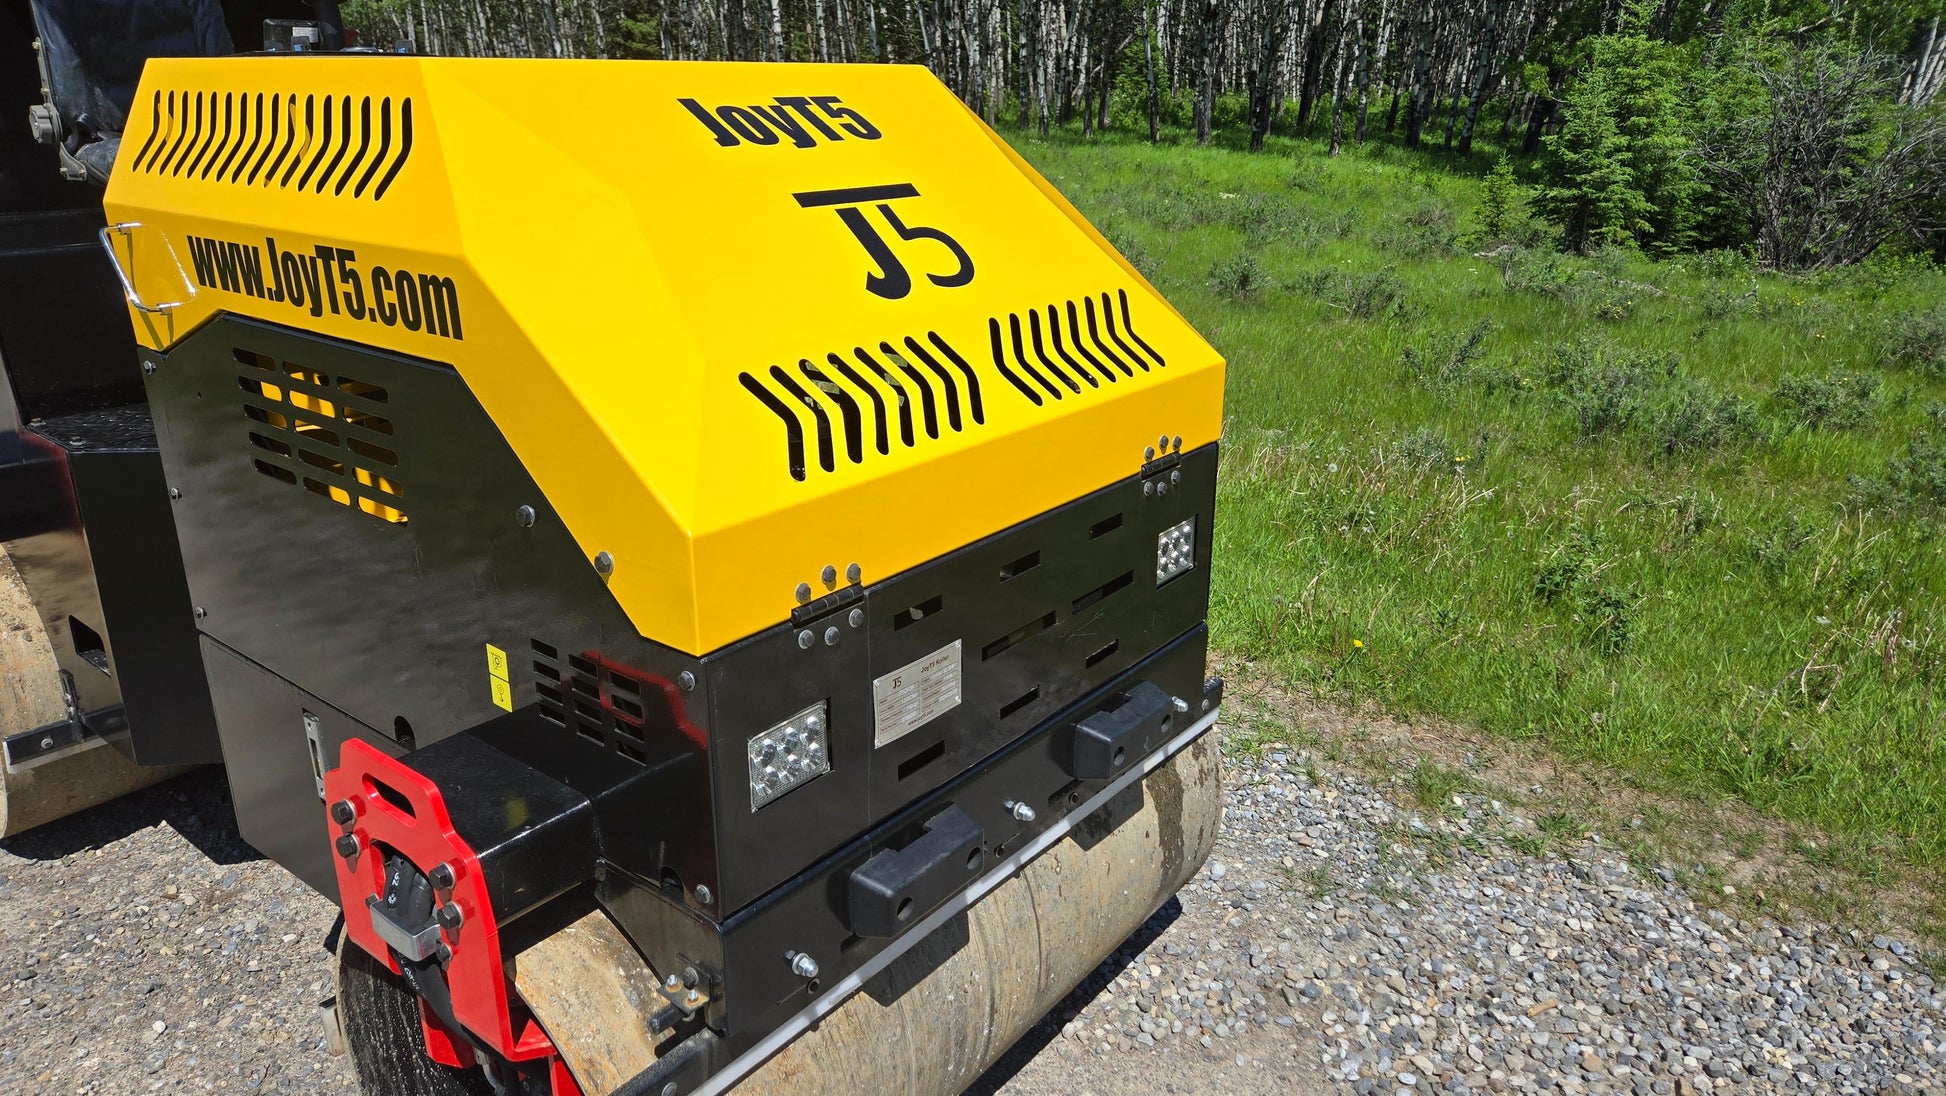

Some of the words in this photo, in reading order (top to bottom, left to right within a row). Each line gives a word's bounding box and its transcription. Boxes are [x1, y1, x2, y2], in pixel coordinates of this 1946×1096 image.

[676, 95, 882, 149] JoyT5
[186, 234, 464, 341] www.JoyT5.com
[791, 182, 975, 300] J5
